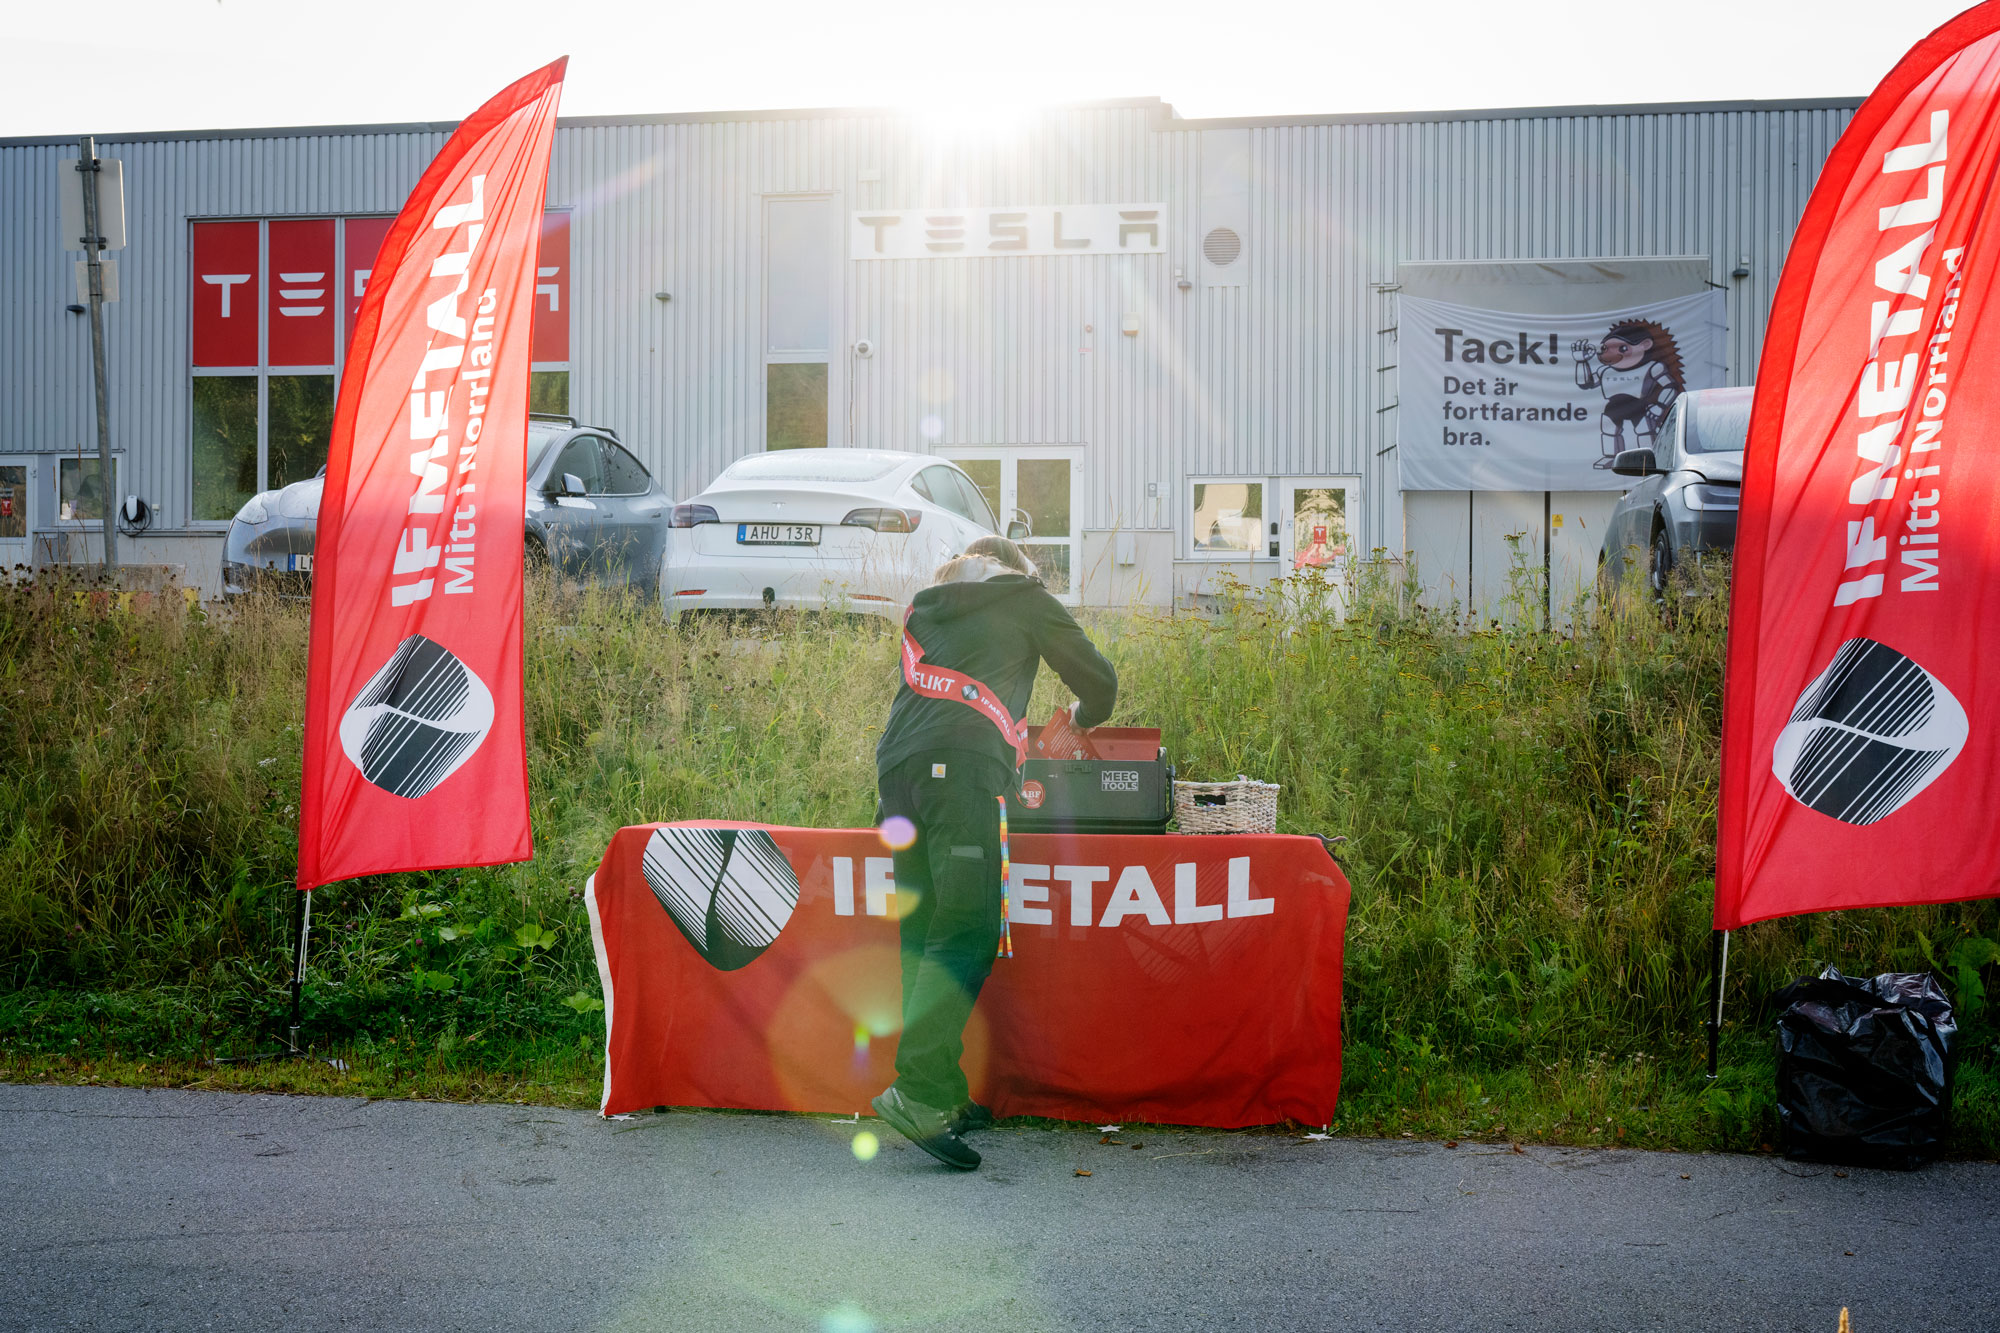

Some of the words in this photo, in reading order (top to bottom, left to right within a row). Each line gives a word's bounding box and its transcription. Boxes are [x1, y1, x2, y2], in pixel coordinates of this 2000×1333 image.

[856, 210, 1160, 254] TESLA
[1848, 109, 1950, 505] METALL
[407, 173, 487, 516] METALL
[1434, 327, 1559, 365] Tack!
[1909, 244, 1967, 454] Norrland
[1443, 375, 1487, 395] Det
[1493, 377, 1519, 396] är
[1442, 400, 1588, 422] fortfarande
[1442, 426, 1491, 446] bra.
[455, 483, 476, 497] i
[1904, 464, 1941, 480] i
[444, 503, 476, 595] Mitt
[750, 526, 780, 541] AHU
[785, 526, 814, 542] 13R
[1899, 488, 1940, 593] Mitt
[391, 527, 442, 607] IF
[1833, 514, 1888, 607] IF
[1102, 771, 1138, 782] MEEC
[1102, 781, 1138, 791] TOOLS
[832, 856, 896, 916] IF
[1008, 855, 1276, 928] ETALL
